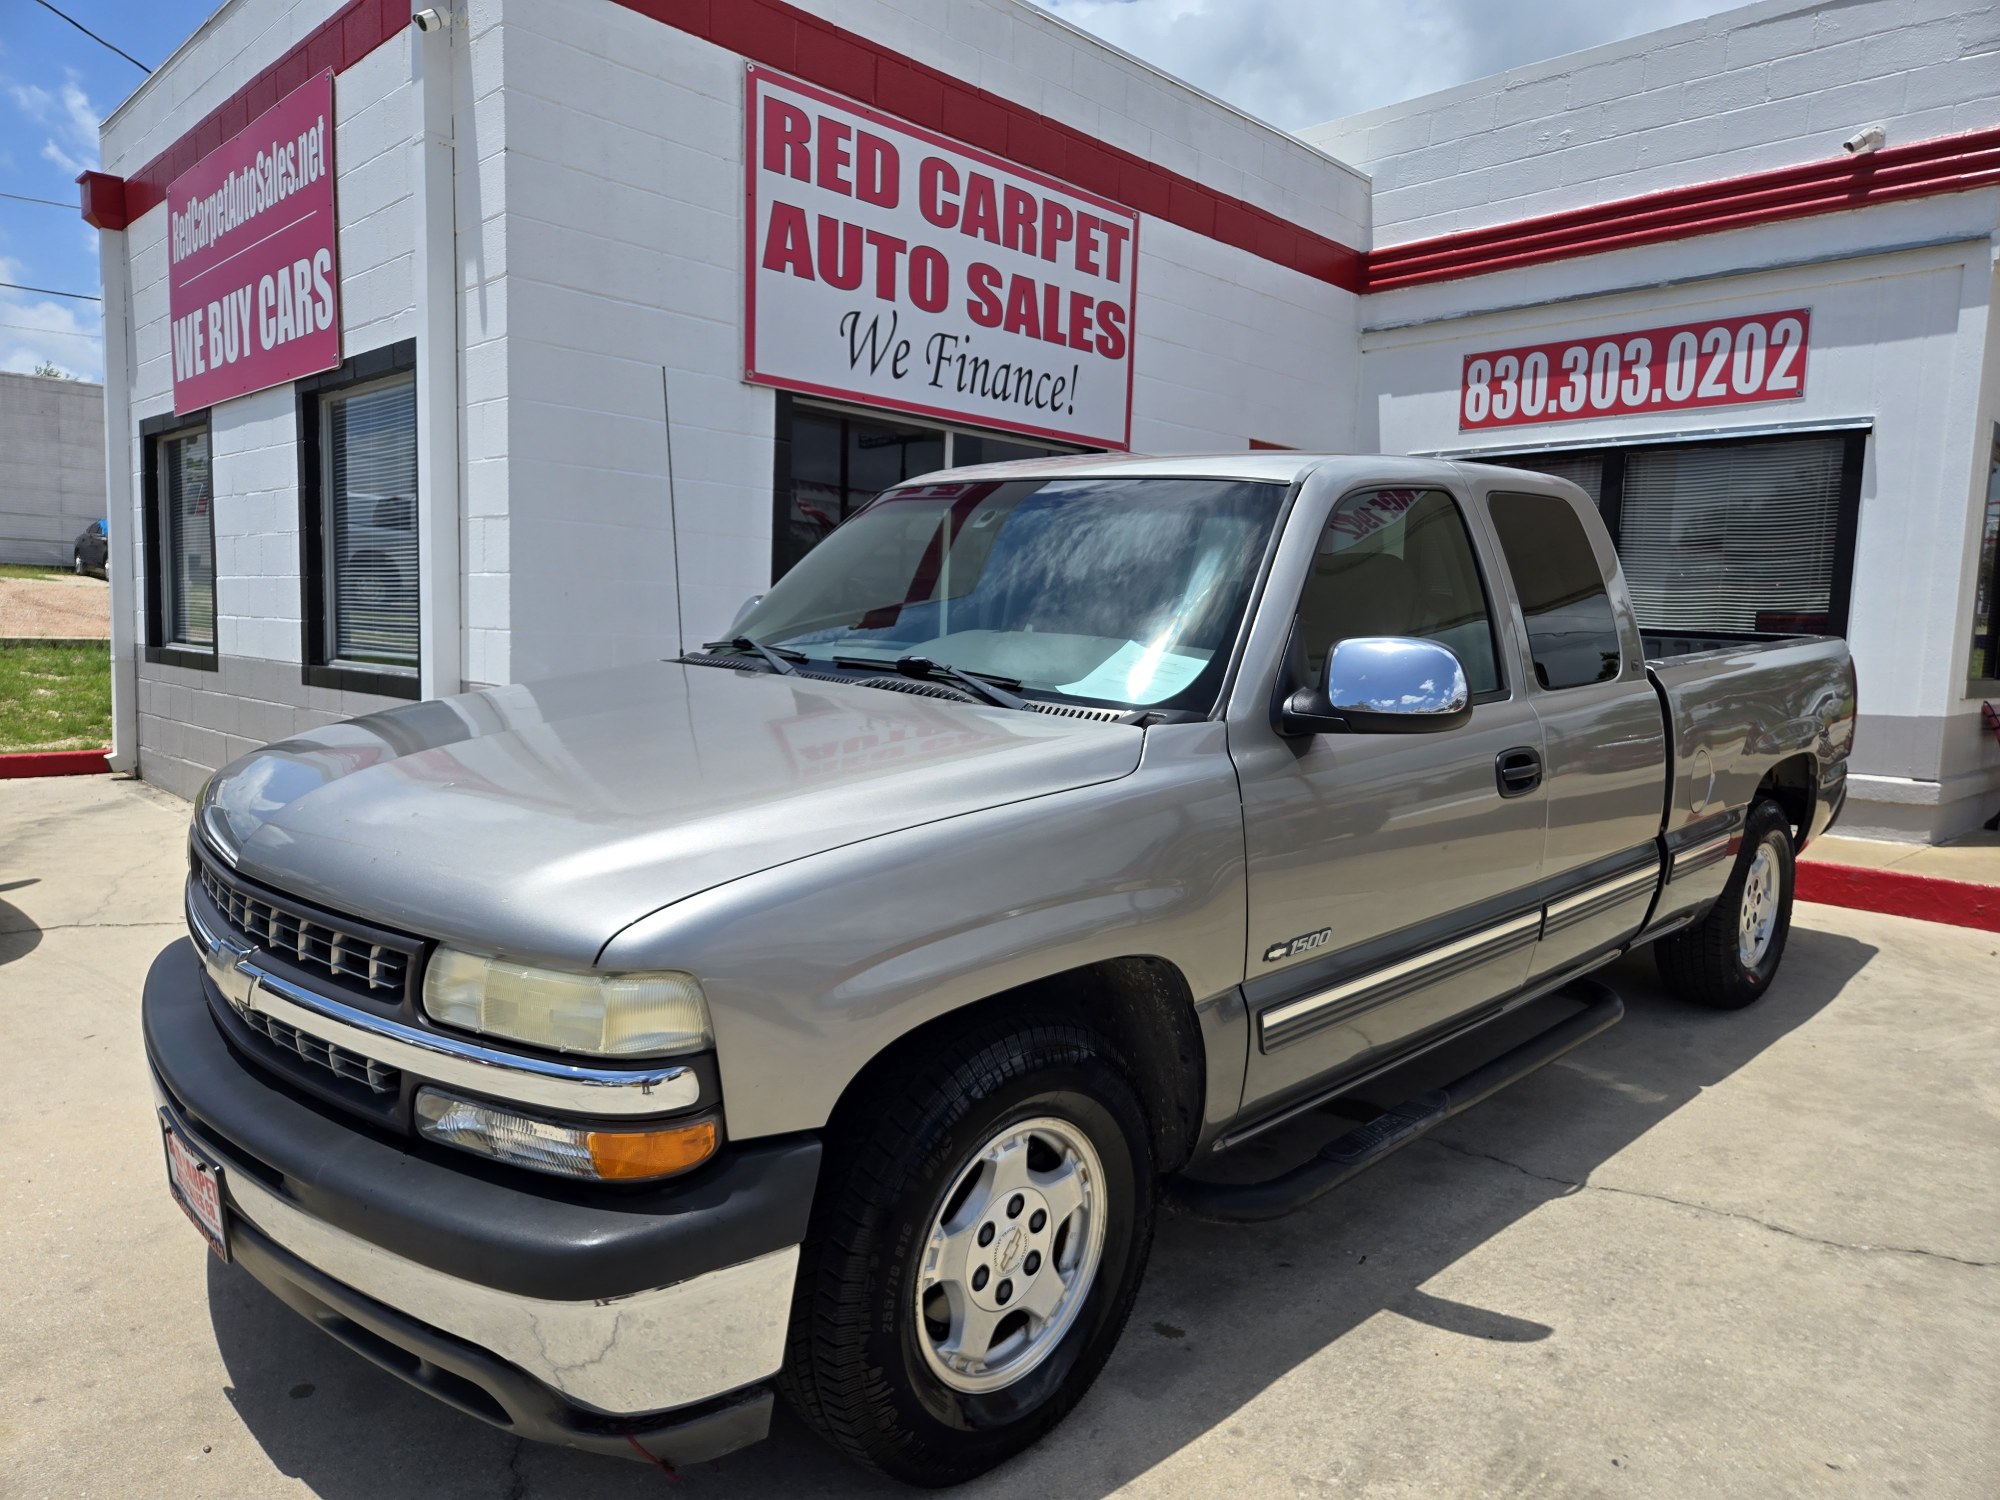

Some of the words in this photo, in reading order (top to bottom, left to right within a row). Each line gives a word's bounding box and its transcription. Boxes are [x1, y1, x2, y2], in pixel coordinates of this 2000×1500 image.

[172, 114, 326, 265] RedCarpetAutoSales.net
[763, 95, 900, 209] RED
[919, 157, 1130, 283] CARPET
[173, 308, 206, 382] WE
[207, 283, 253, 370] BUY
[258, 248, 334, 351] CARS
[762, 200, 949, 313] AUTO
[966, 262, 1126, 360] SALES
[839, 310, 911, 380] We
[925, 333, 1079, 415] Finance!
[1464, 317, 1803, 422] 830.303.0202
[1290, 928, 1333, 955] 1500
